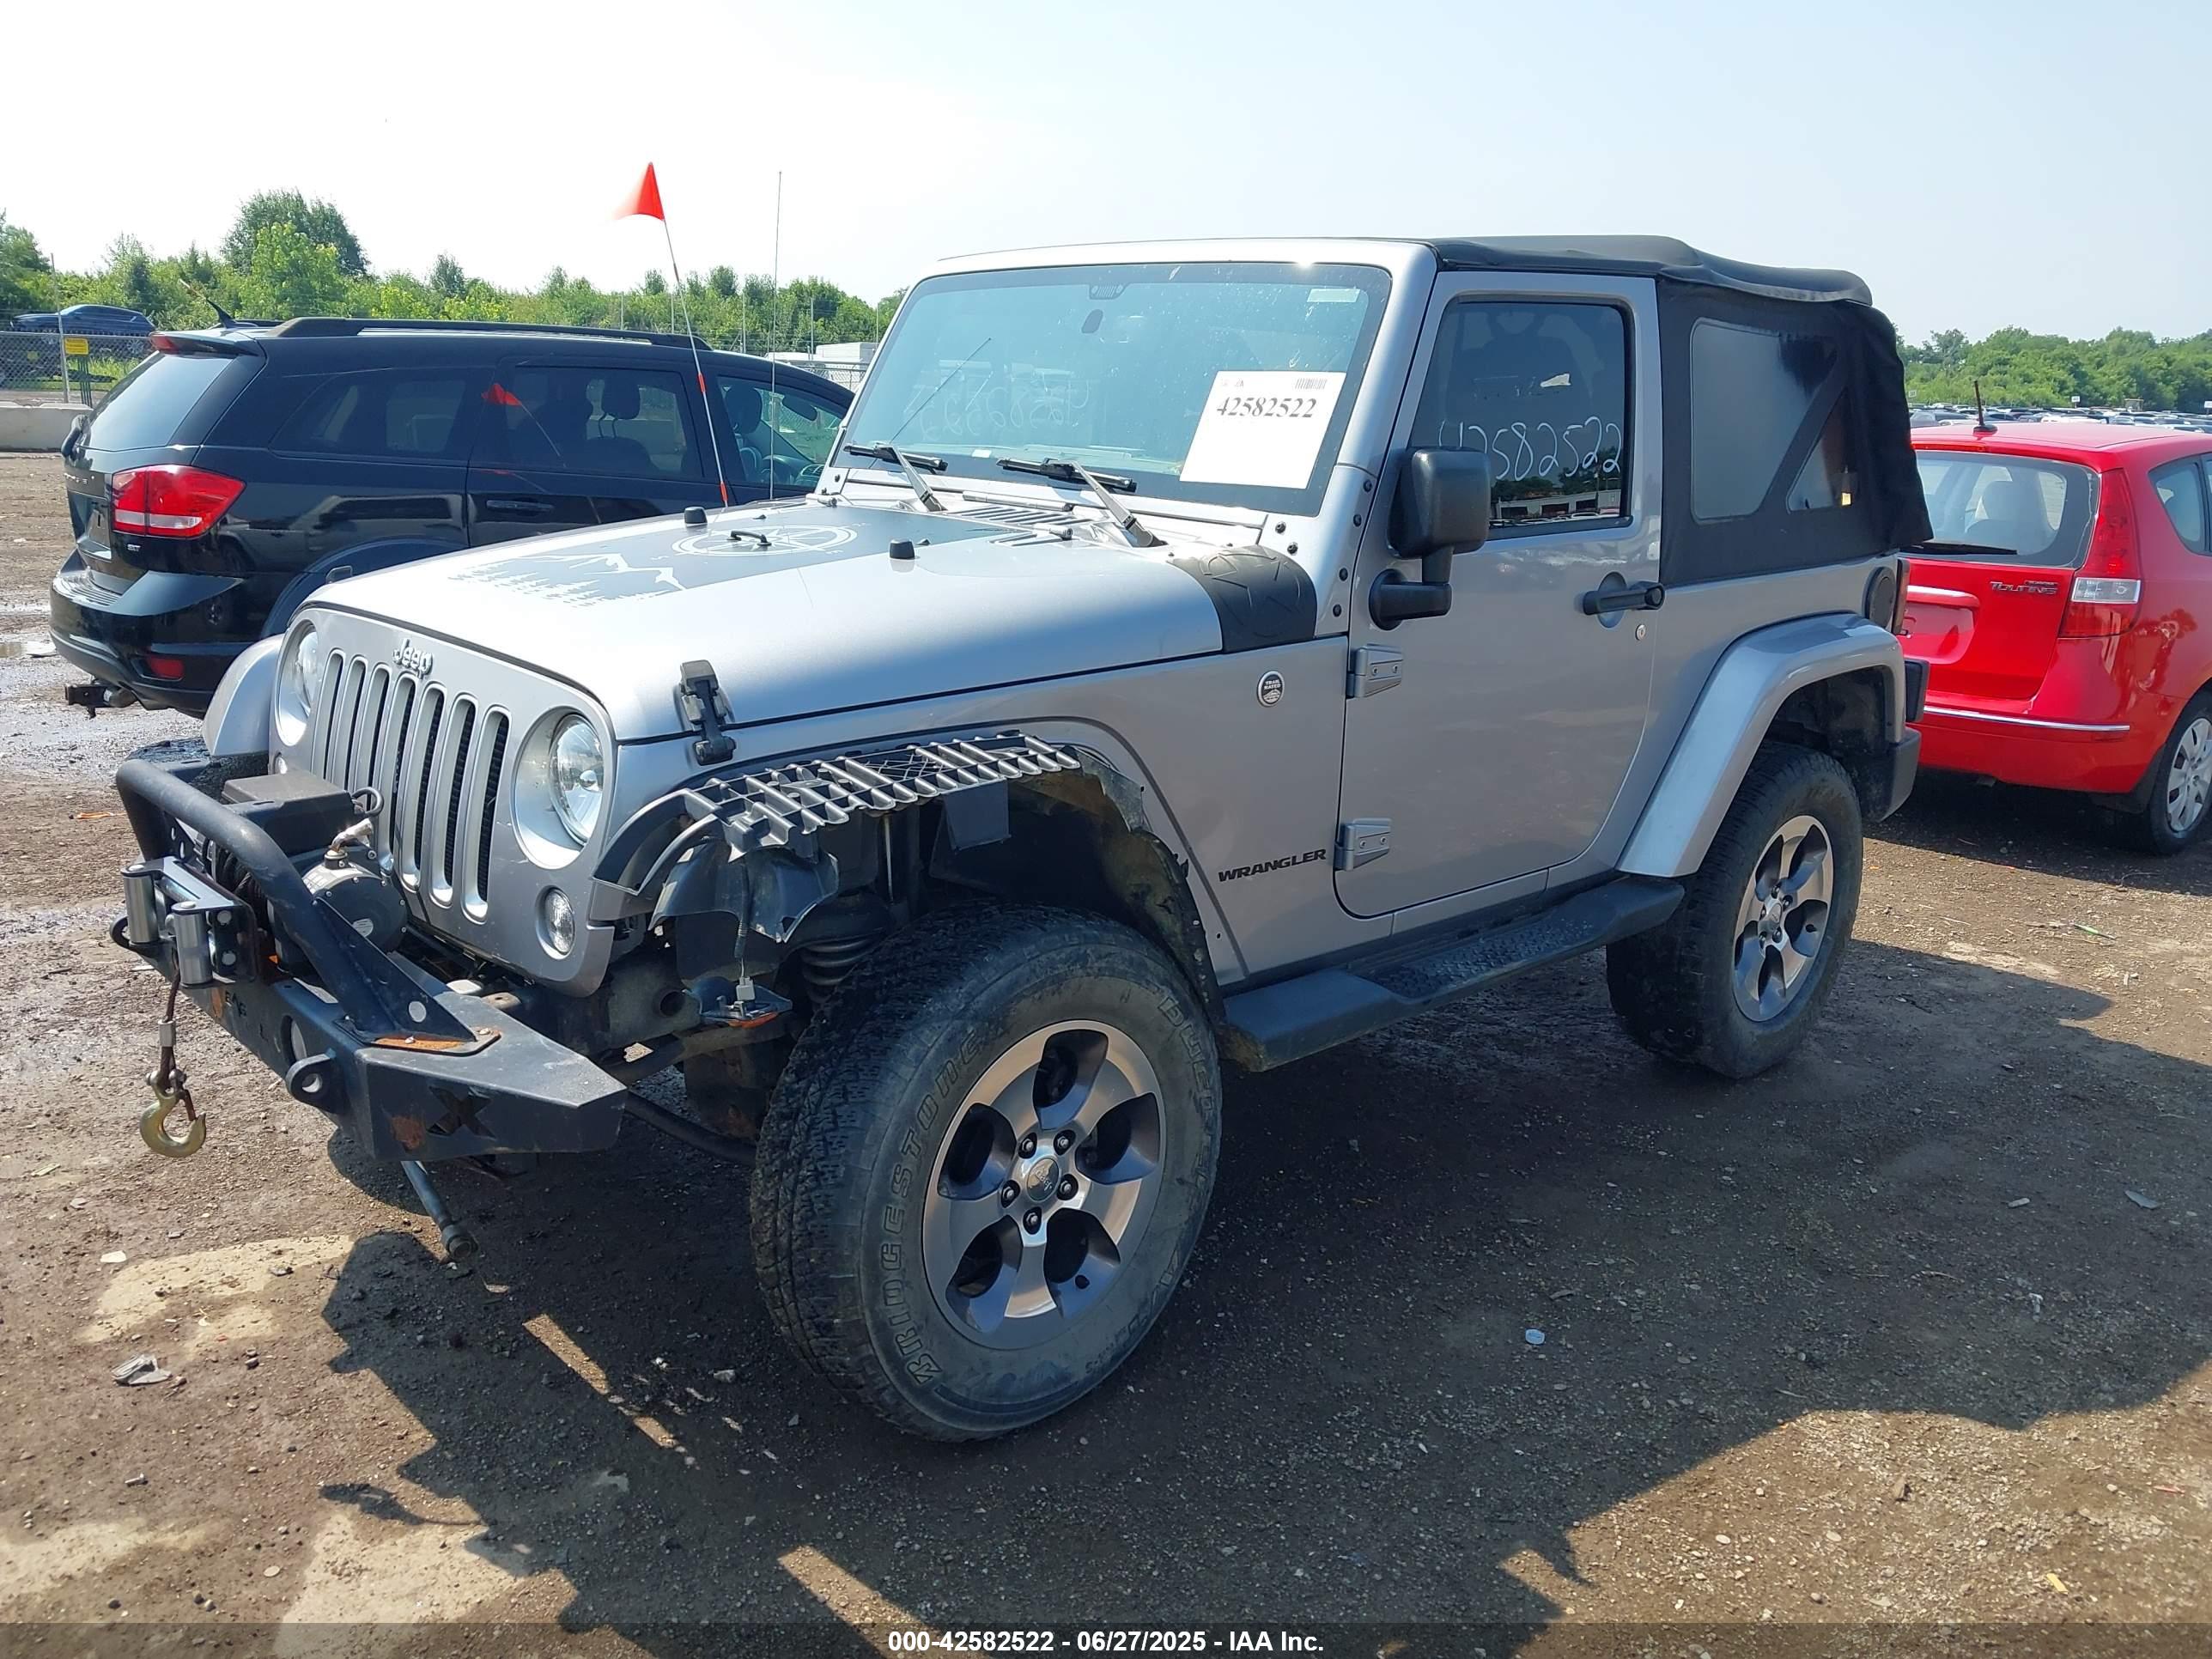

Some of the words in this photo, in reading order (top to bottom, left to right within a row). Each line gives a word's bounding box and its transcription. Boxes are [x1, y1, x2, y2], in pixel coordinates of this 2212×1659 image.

[1217, 397, 1317, 418] 42582522
[392, 638, 434, 680] Jeep
[1218, 848, 1327, 882] WRANGLER
[881, 1030, 981, 1385] BRIDGESTONE
